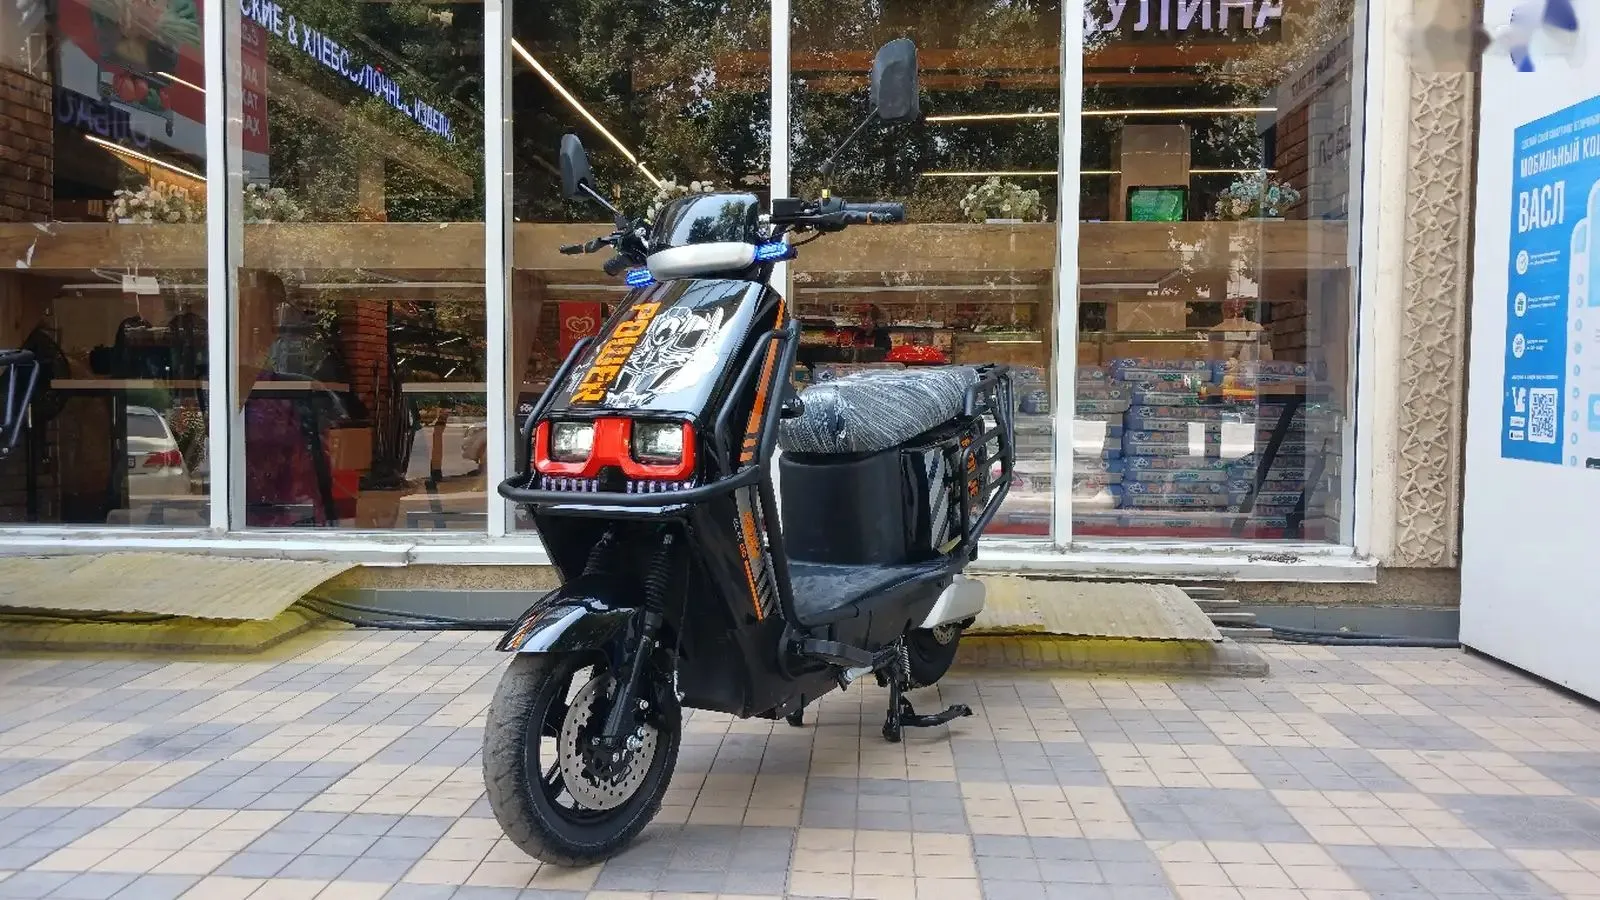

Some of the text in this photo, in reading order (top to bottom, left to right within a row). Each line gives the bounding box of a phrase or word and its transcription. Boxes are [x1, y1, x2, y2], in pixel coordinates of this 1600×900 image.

[288, 15, 298, 48] &
[415, 97, 456, 144] ИЗДЕЛИ
[1520, 137, 1579, 178] МОБИЛЬНЫЙ
[1518, 181, 1565, 233] ВАСЛ
[570, 302, 662, 403] POWER
